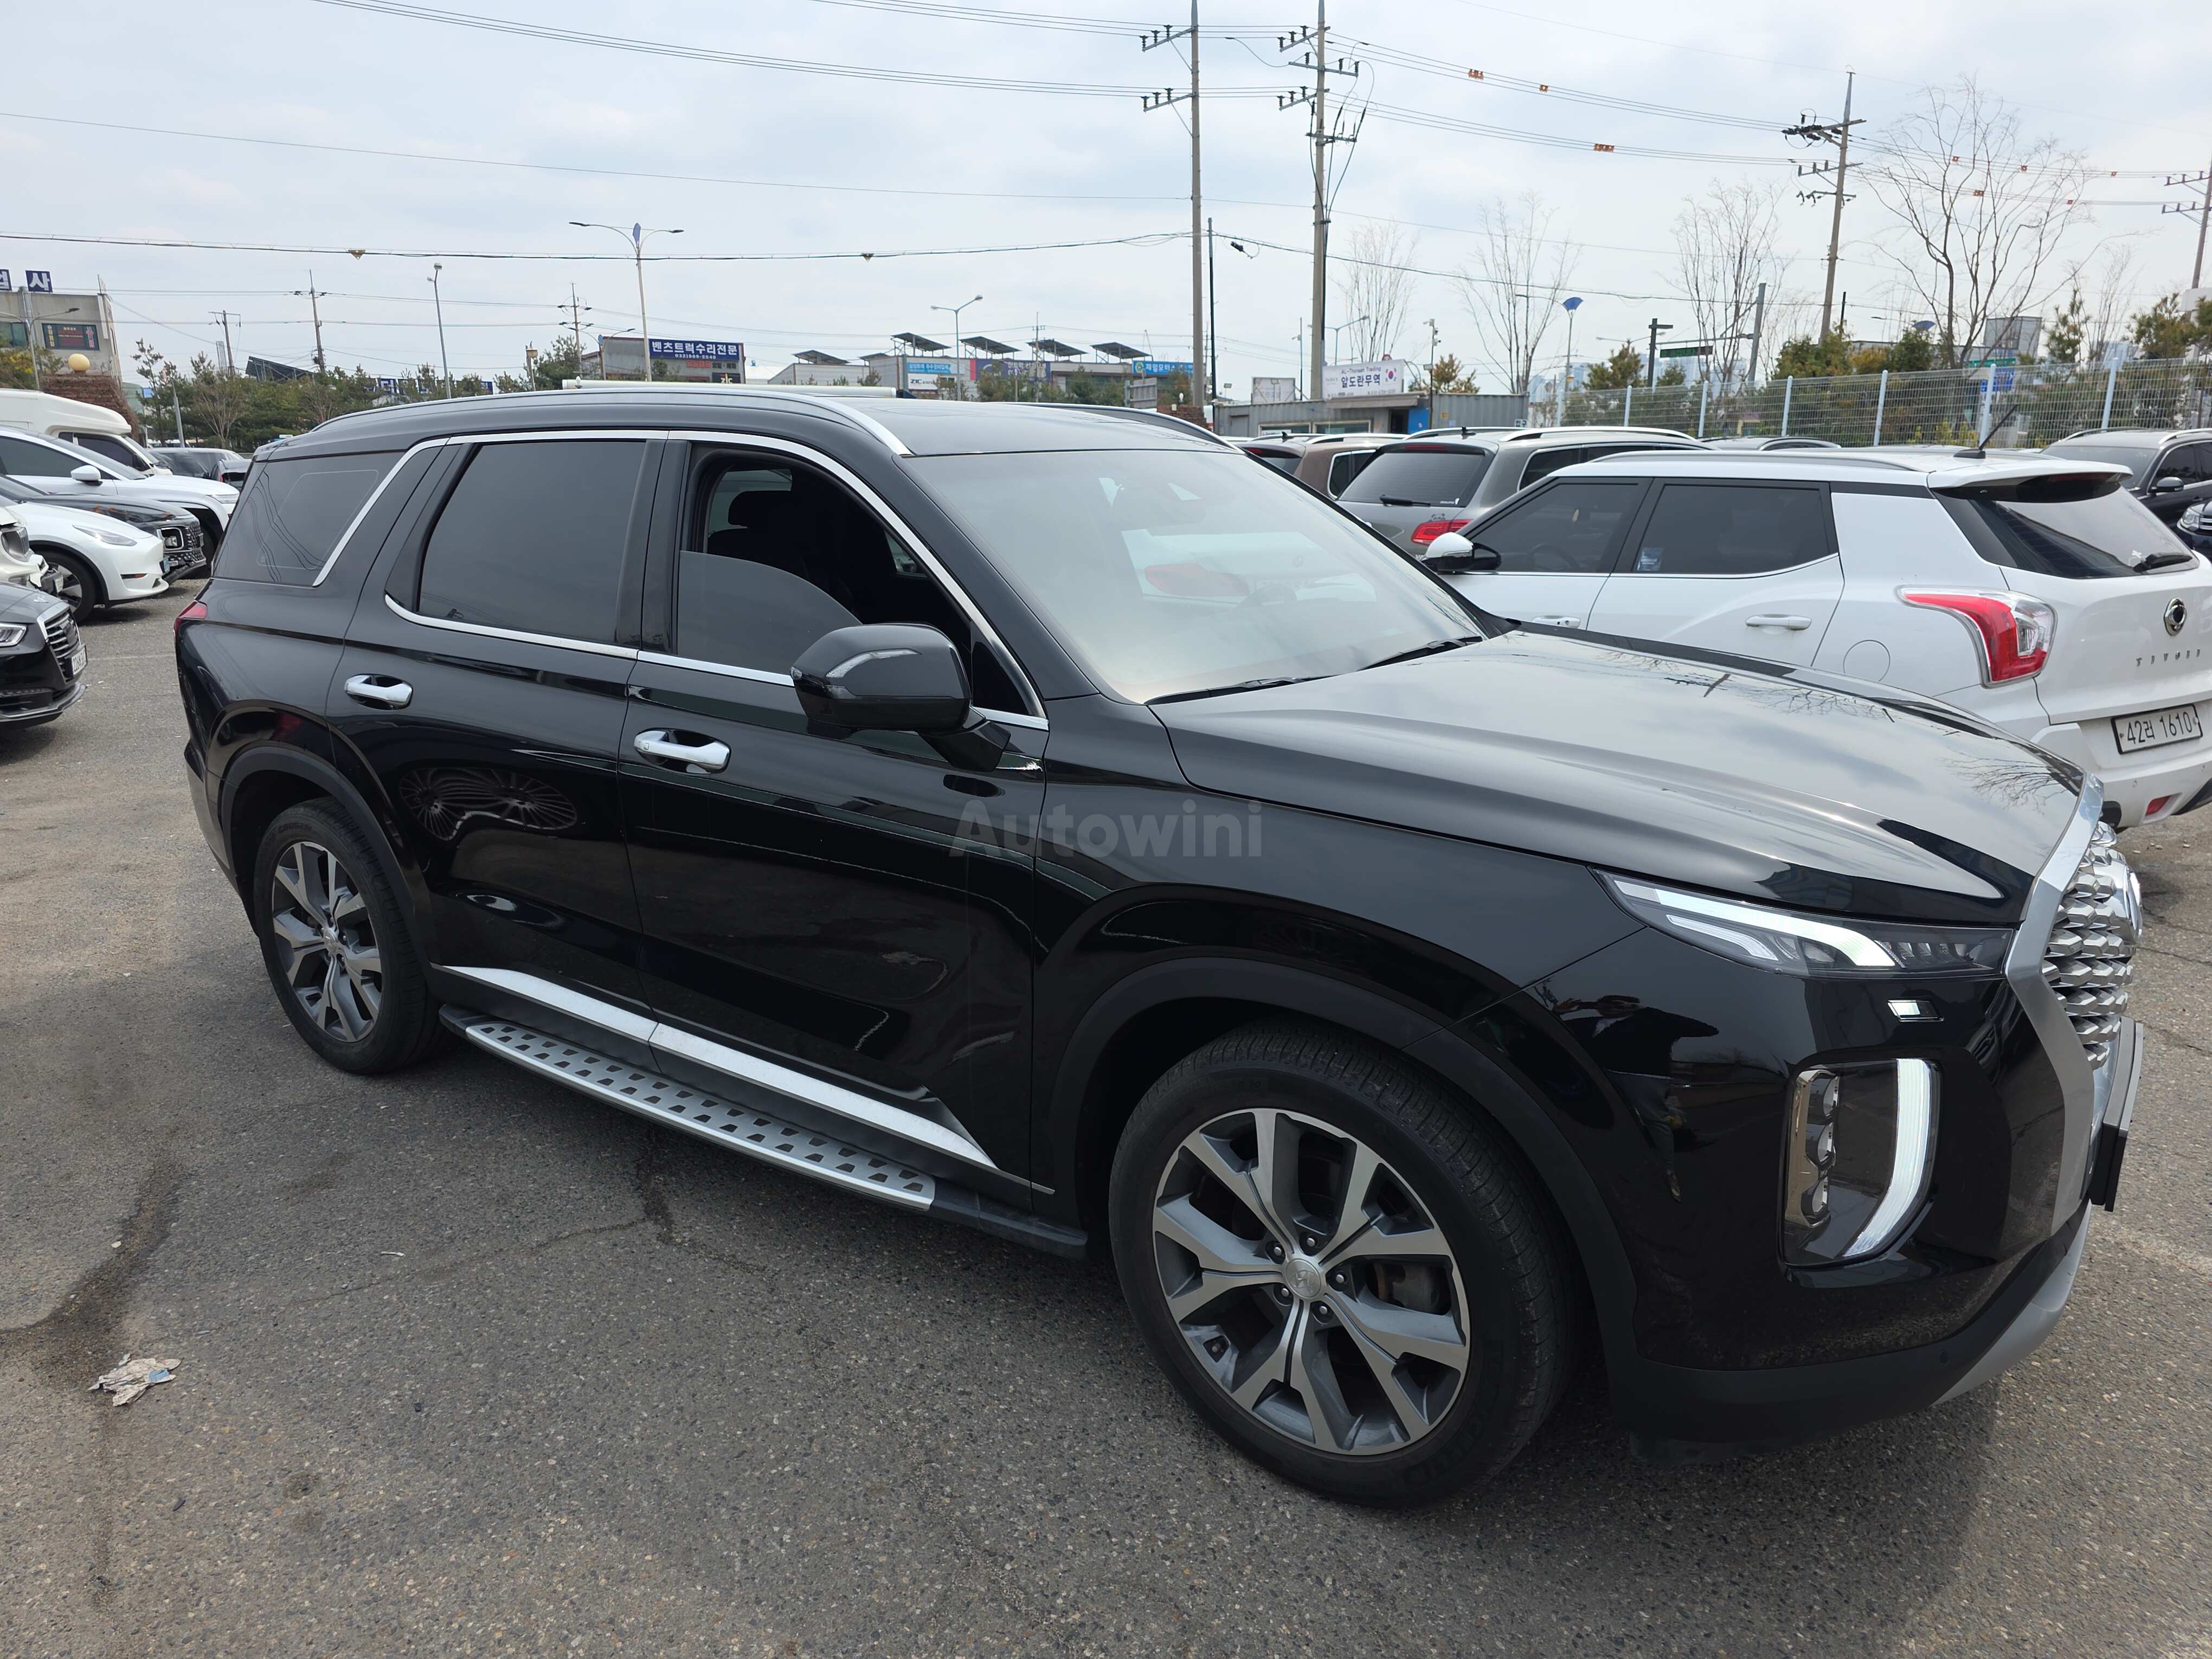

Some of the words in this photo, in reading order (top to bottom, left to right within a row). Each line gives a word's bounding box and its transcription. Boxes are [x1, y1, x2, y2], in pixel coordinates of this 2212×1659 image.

[652, 342, 737, 355] 벤츠트럭수리전문
[1341, 374, 1380, 388] 알도란무역
[2127, 719, 2155, 744] 42러
[2159, 711, 2192, 737] 1610
